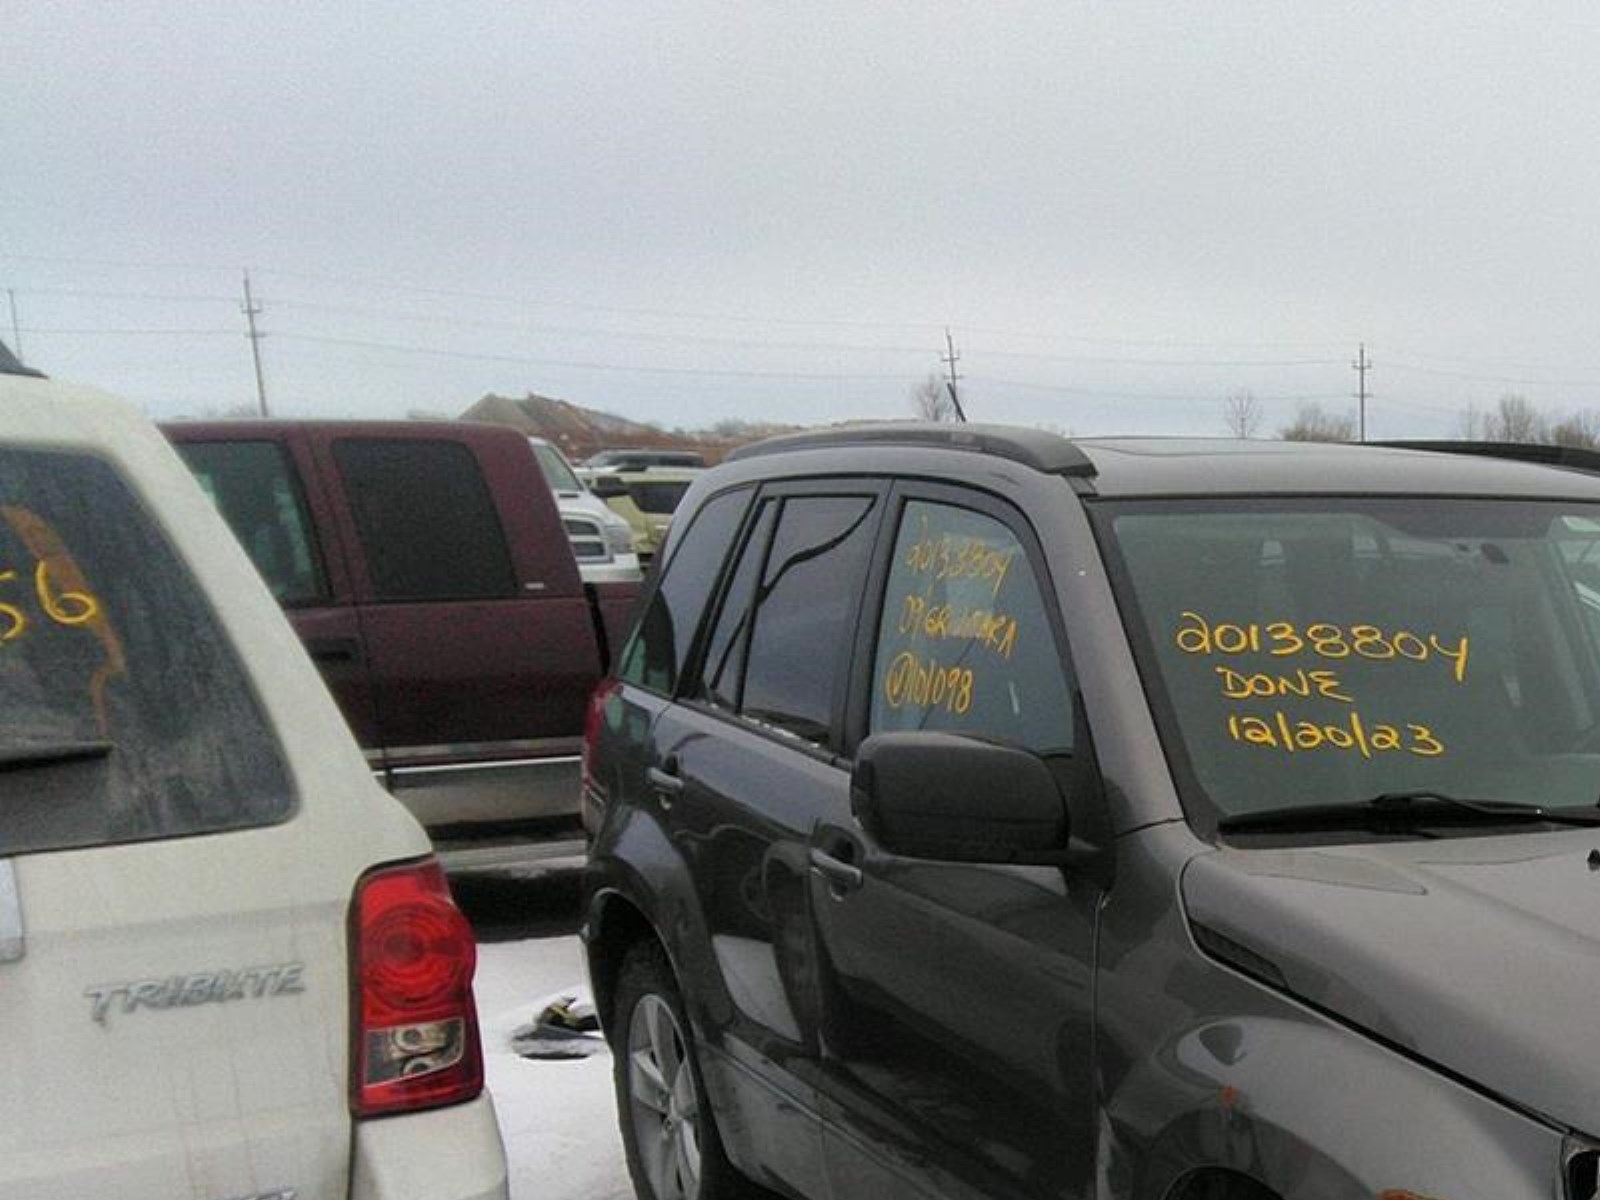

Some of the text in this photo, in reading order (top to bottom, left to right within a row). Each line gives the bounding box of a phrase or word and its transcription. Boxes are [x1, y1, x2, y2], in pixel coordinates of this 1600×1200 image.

[1176, 611, 1468, 682] 20138804
[1215, 666, 1353, 702] DONE
[1228, 711, 1444, 759] 12/20/23
[84, 962, 306, 1025] TRIBUTE
